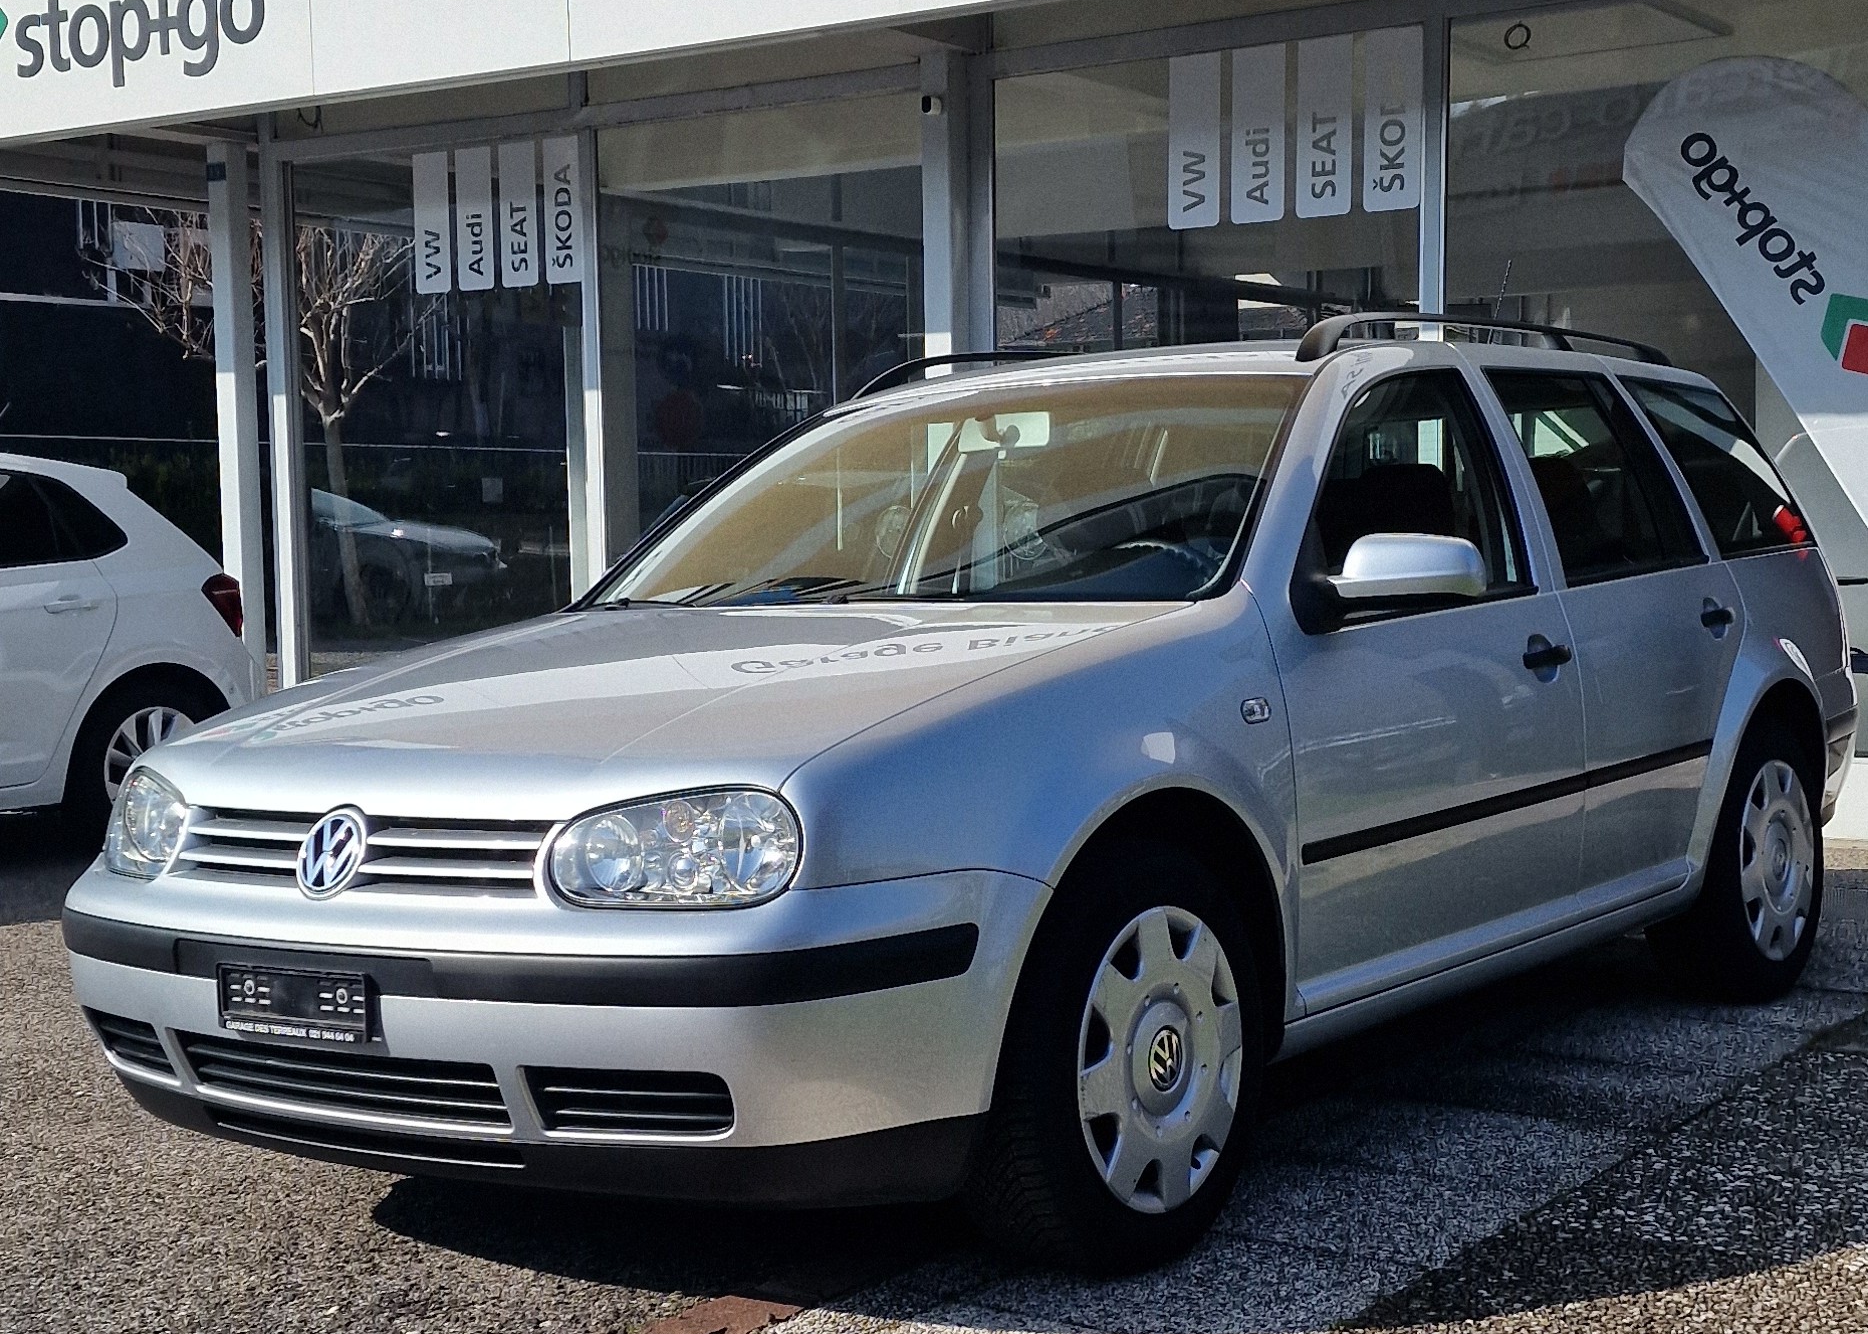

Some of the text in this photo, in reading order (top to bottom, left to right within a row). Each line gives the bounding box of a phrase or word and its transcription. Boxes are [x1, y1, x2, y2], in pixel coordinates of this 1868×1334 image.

[1182, 150, 1206, 213] VW
[1245, 127, 1270, 205] Audi
[1311, 111, 1338, 199] SEAT
[1372, 102, 1407, 193] ŠKO
[465, 212, 484, 277] Audi
[509, 201, 529, 273] SEAT
[551, 163, 574, 269] ŠKODA
[423, 229, 443, 281] VW
